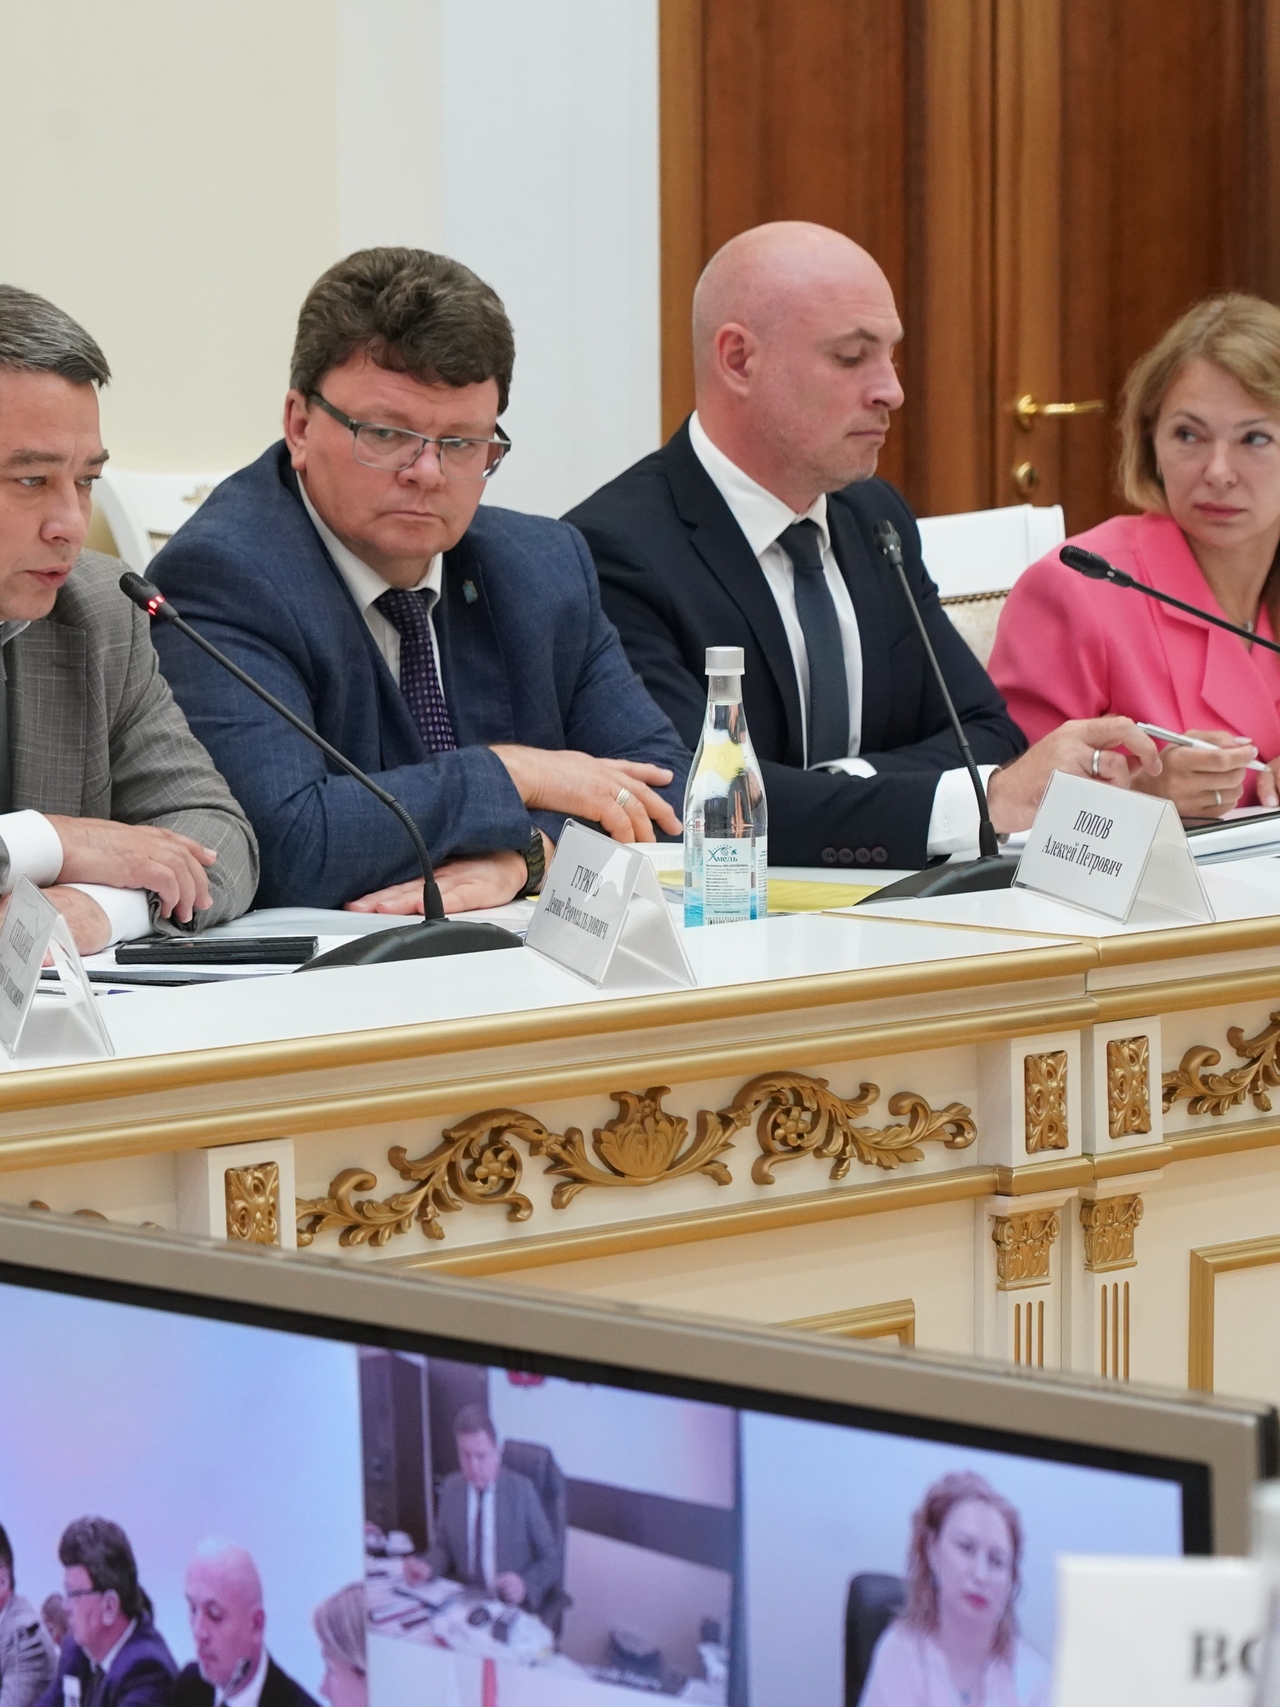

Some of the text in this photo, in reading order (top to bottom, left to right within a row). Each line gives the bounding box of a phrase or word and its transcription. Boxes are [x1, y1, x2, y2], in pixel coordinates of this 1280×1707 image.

[1073, 810, 1114, 840] ПОПОВ
[1041, 834, 1123, 878] Алексей Петрович
[570, 864, 604, 897] ГУРКОВ
